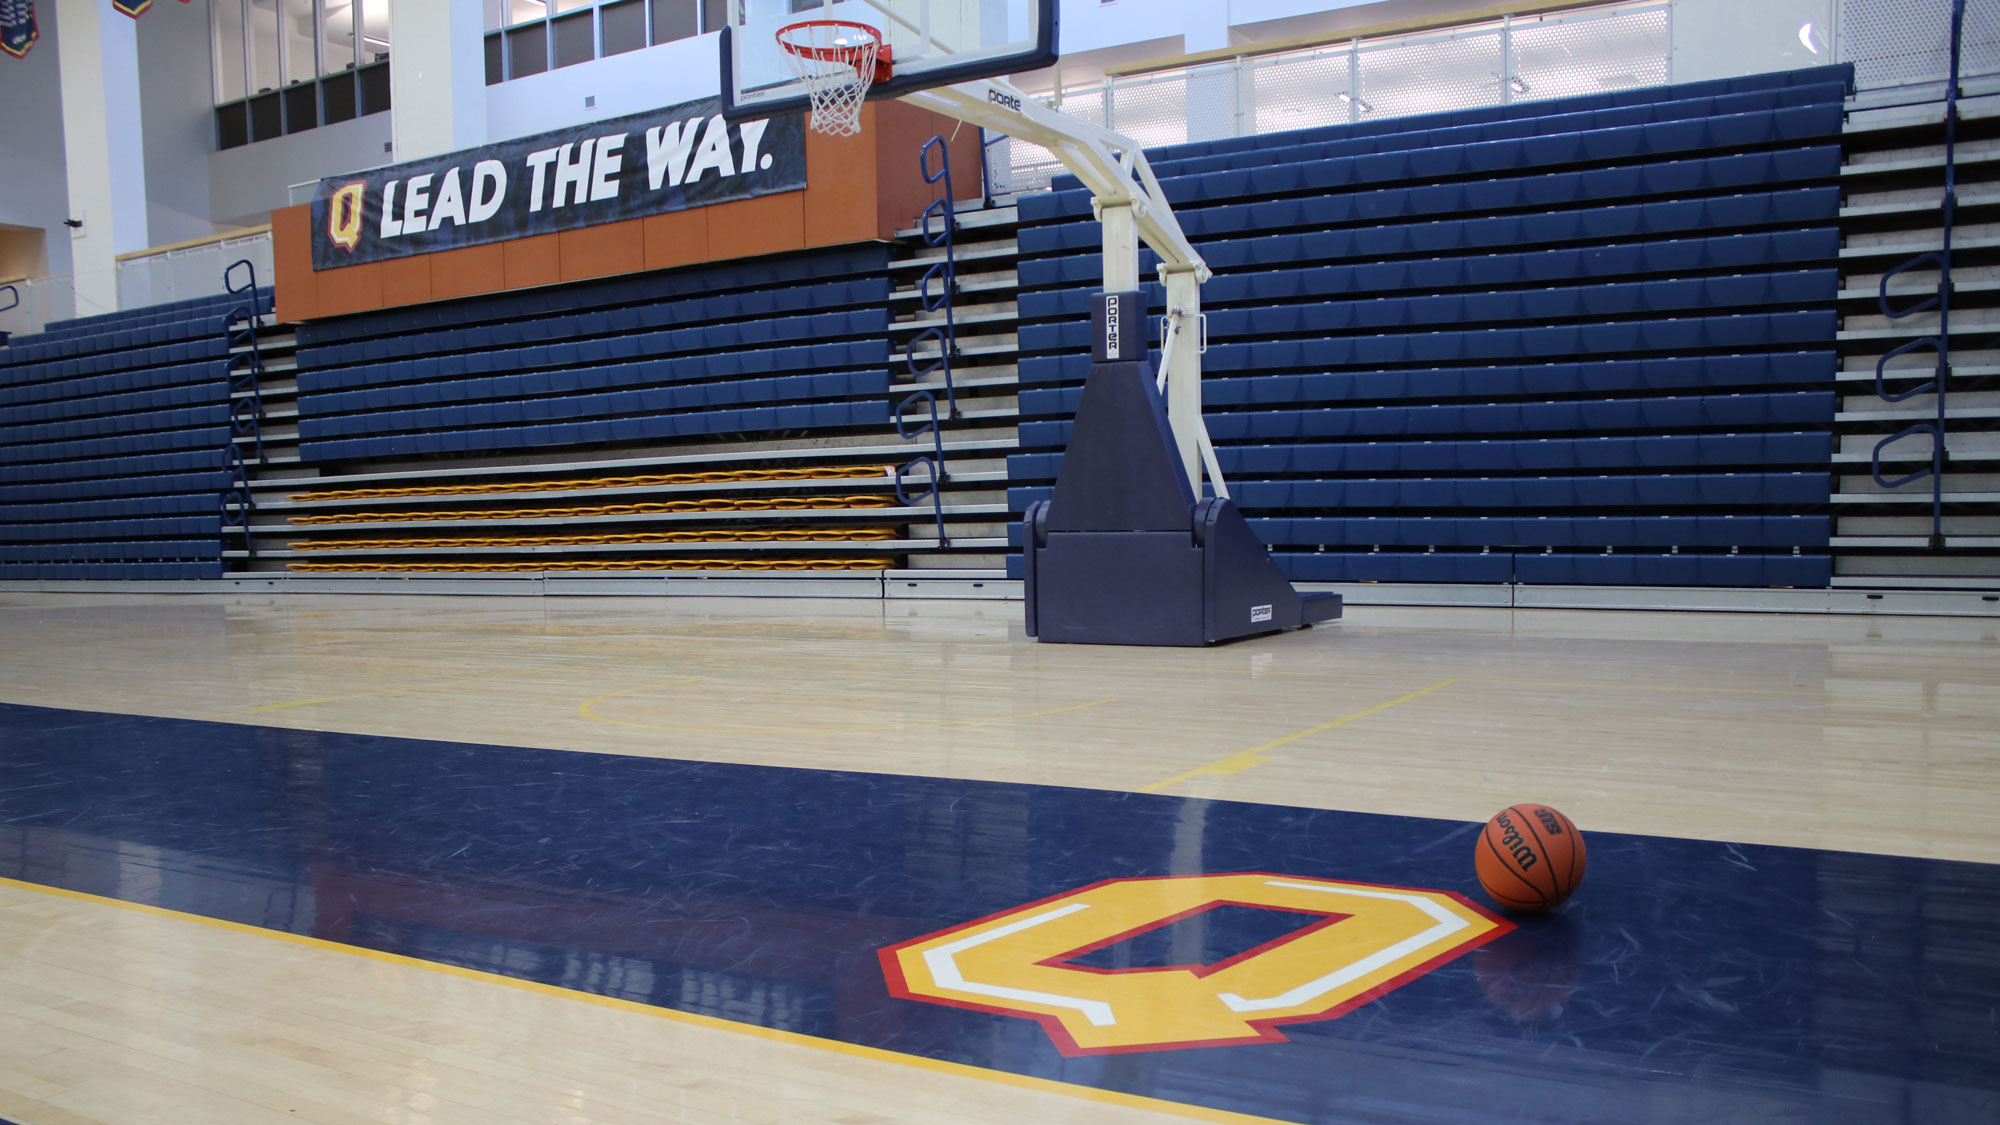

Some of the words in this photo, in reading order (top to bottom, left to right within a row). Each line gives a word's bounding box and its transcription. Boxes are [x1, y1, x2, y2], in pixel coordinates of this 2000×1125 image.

[328, 179, 367, 254] Q
[380, 159, 507, 239] LEAD
[526, 132, 629, 213] THE
[646, 113, 773, 191] WAY.
[1496, 812, 1537, 873] Wilson
[876, 872, 1519, 1058] Q
